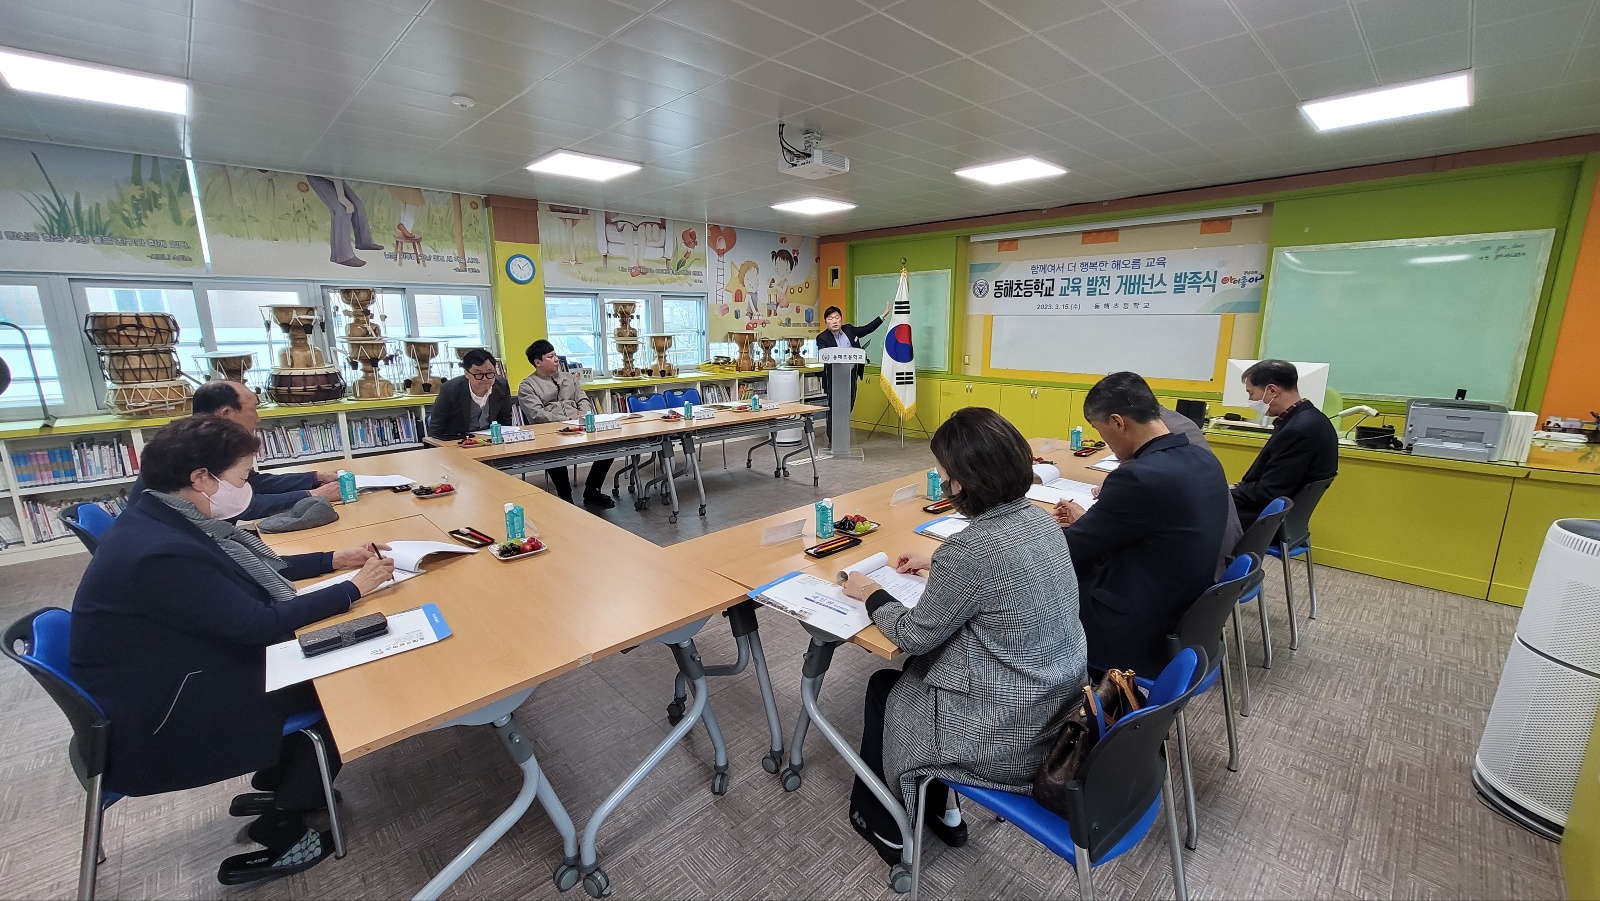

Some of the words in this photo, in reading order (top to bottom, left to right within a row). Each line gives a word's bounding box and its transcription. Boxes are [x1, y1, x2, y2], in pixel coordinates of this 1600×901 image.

[1031, 264, 1064, 275] 함께여서
[1067, 262, 1077, 273] 더
[1080, 260, 1108, 272] 행복한
[1112, 259, 1141, 270] 해오름
[1145, 256, 1167, 268] 교육
[993, 278, 1055, 298] 동해초등학교
[1059, 276, 1082, 297] 교육
[1087, 275, 1111, 296] 발전
[1115, 272, 1168, 295] 거버넌스
[1173, 270, 1218, 294] 발족식
